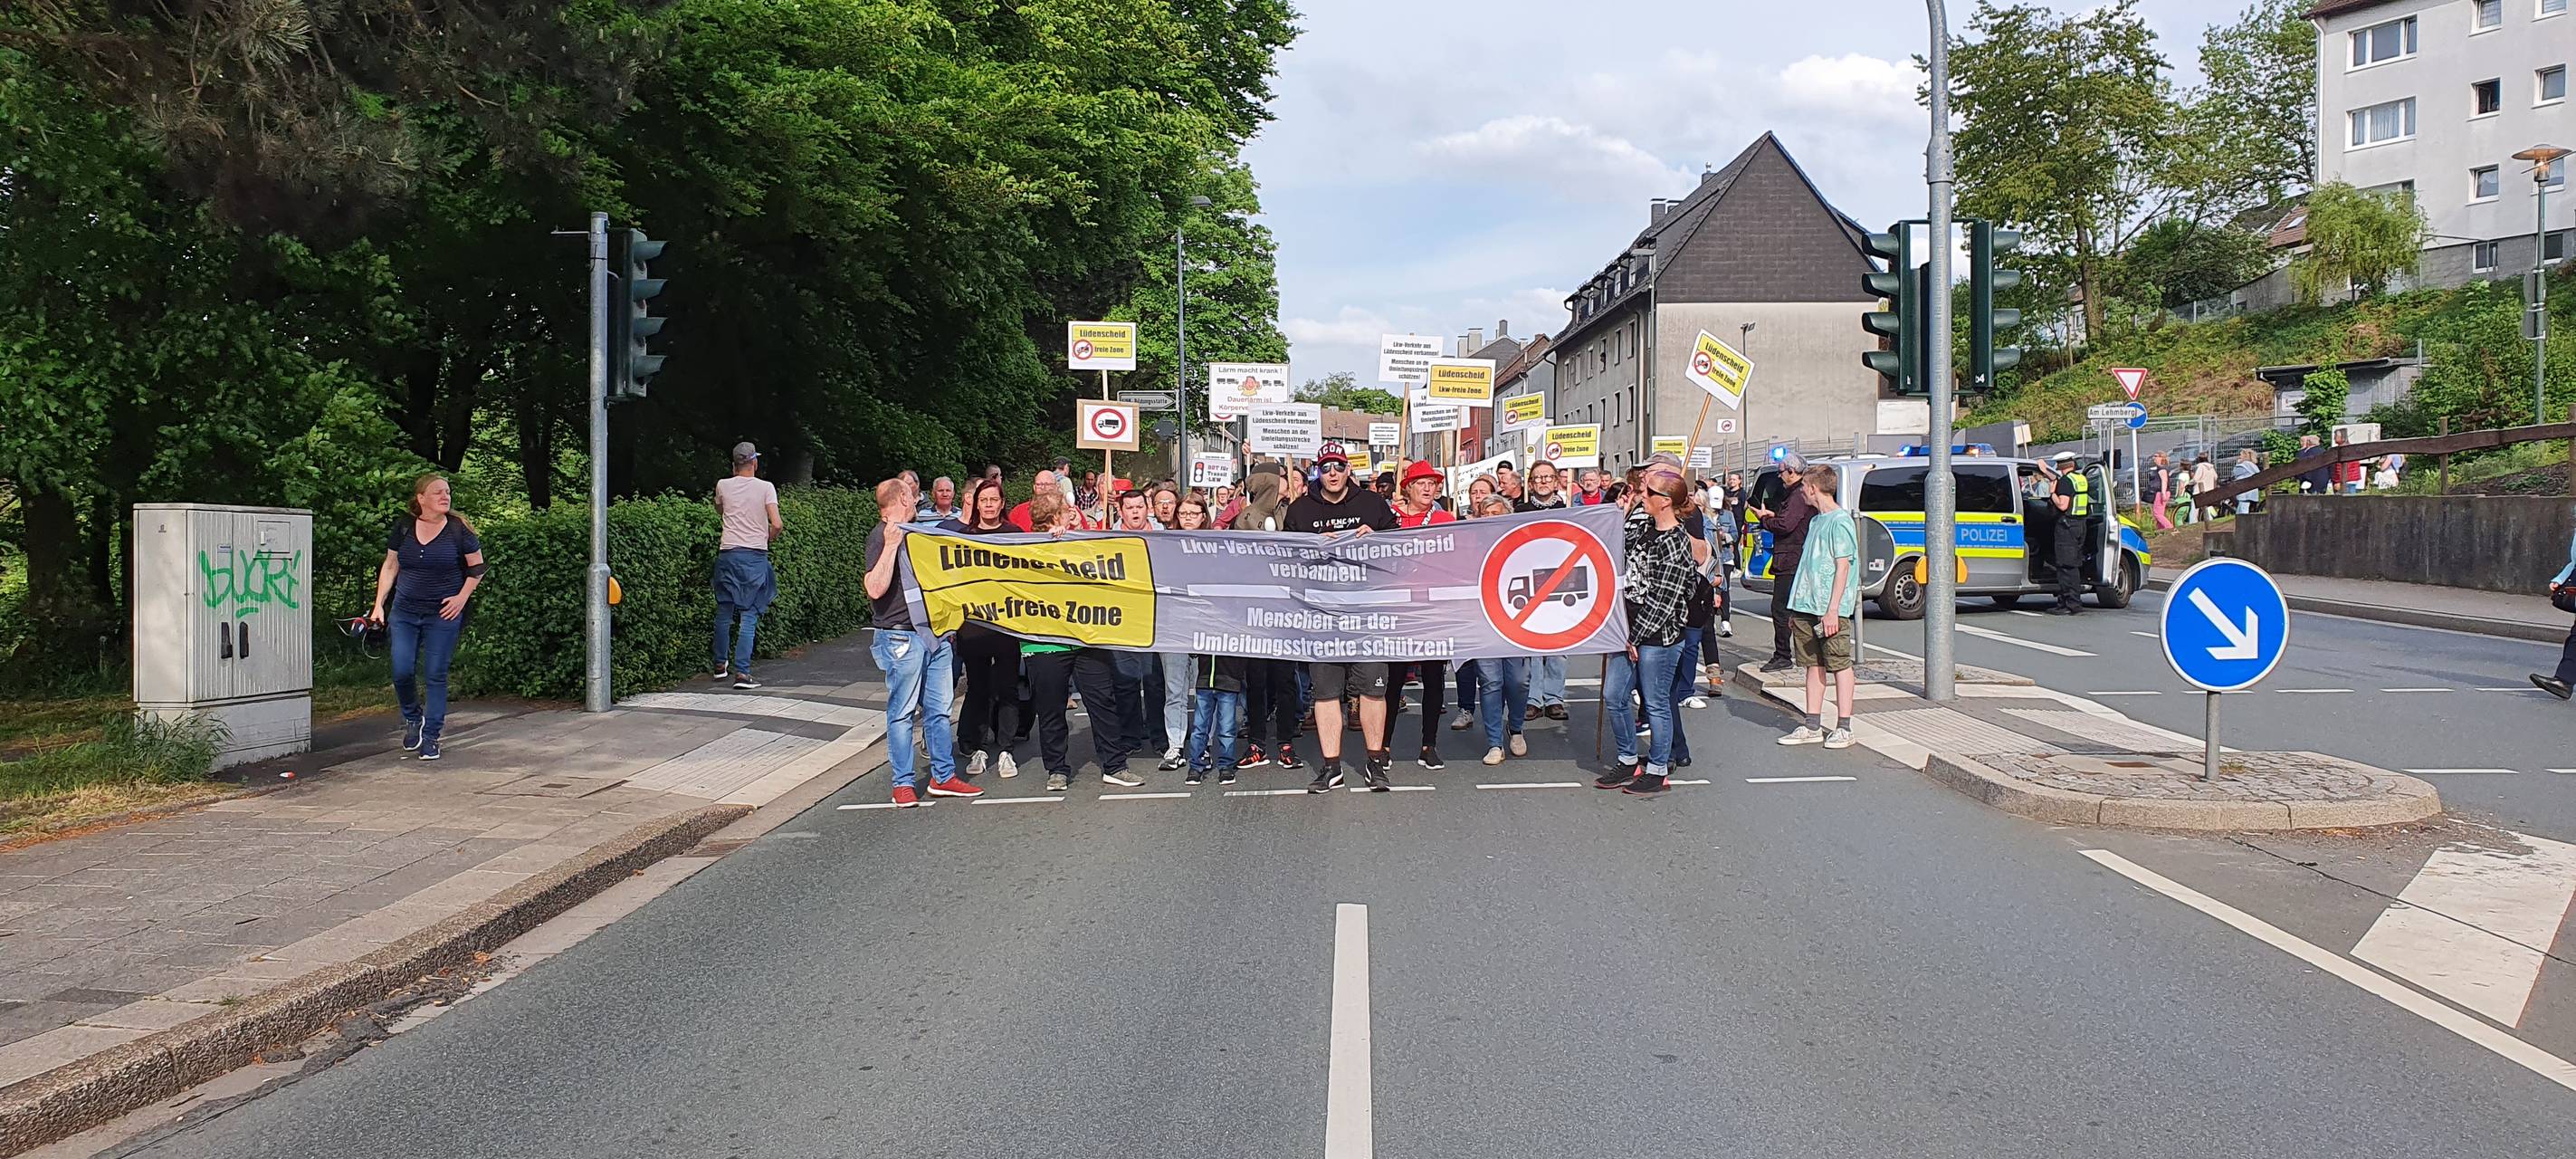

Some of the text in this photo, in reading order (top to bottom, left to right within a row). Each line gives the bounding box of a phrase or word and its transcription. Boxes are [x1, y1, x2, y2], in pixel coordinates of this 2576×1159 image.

[1080, 330, 1126, 338] Lüdenscheid
[1705, 342, 1743, 373] Lüdenscheid
[1438, 369, 1484, 379] Lüdenscheid
[1713, 367, 1723, 378] freie
[1723, 375, 1736, 388] Zone
[1510, 398, 1539, 407] Lüdenscheid
[1552, 431, 1591, 440] Lüdenscheid
[1319, 445, 1342, 457] ICON
[1961, 528, 2007, 541] POLIZEI
[1180, 538, 1293, 558] Lkw-Verkehr
[1335, 534, 1455, 560] Lüdenscheid
[1269, 562, 1367, 582] verbannen!
[1065, 601, 1122, 626] Zone
[1246, 607, 1398, 630] Menschen an der
[1192, 631, 1454, 656] Umleitungsstrecke schützen!
